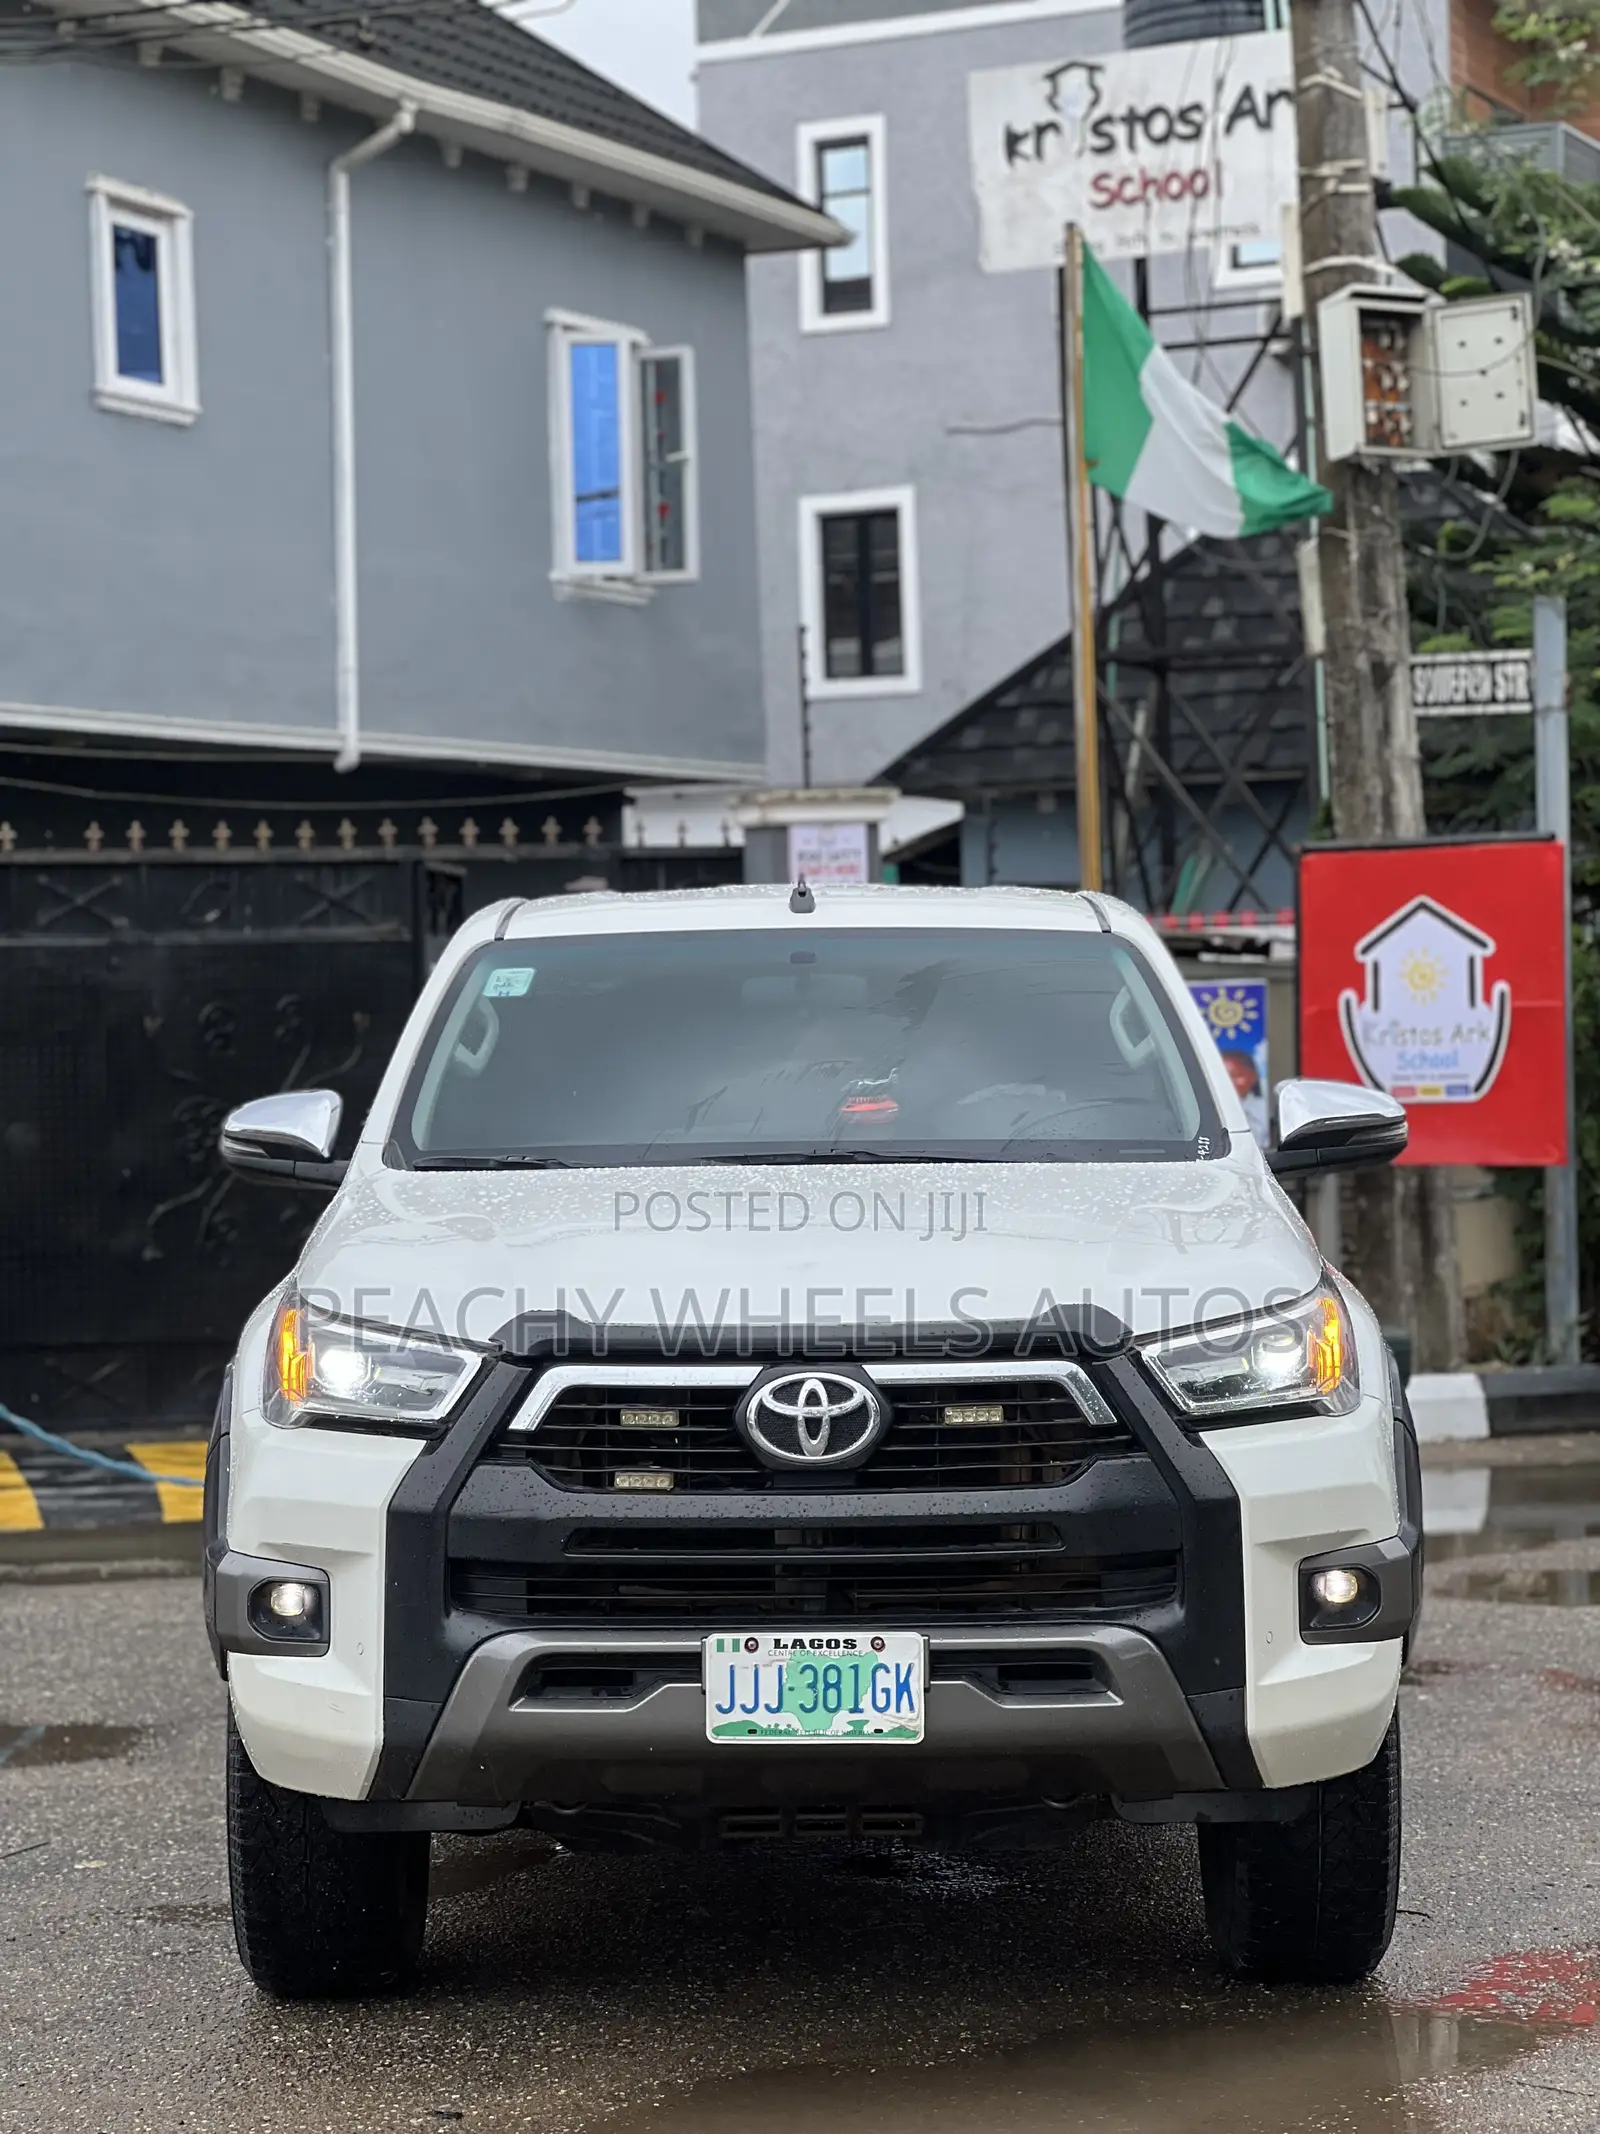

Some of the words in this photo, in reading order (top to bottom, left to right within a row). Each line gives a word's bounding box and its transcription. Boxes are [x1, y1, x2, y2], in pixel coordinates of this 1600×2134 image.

[1224, 84, 1297, 135] Ar
[1449, 1020, 1493, 1044] Ark
[1396, 1049, 1459, 1071] School
[773, 1638, 858, 1650] LAGOS
[767, 1649, 797, 1657] CENTRE
[799, 1649, 811, 1657] OF
[812, 1649, 863, 1657] EXCELLENCE
[760, 1728, 791, 1736] FEDERAL
